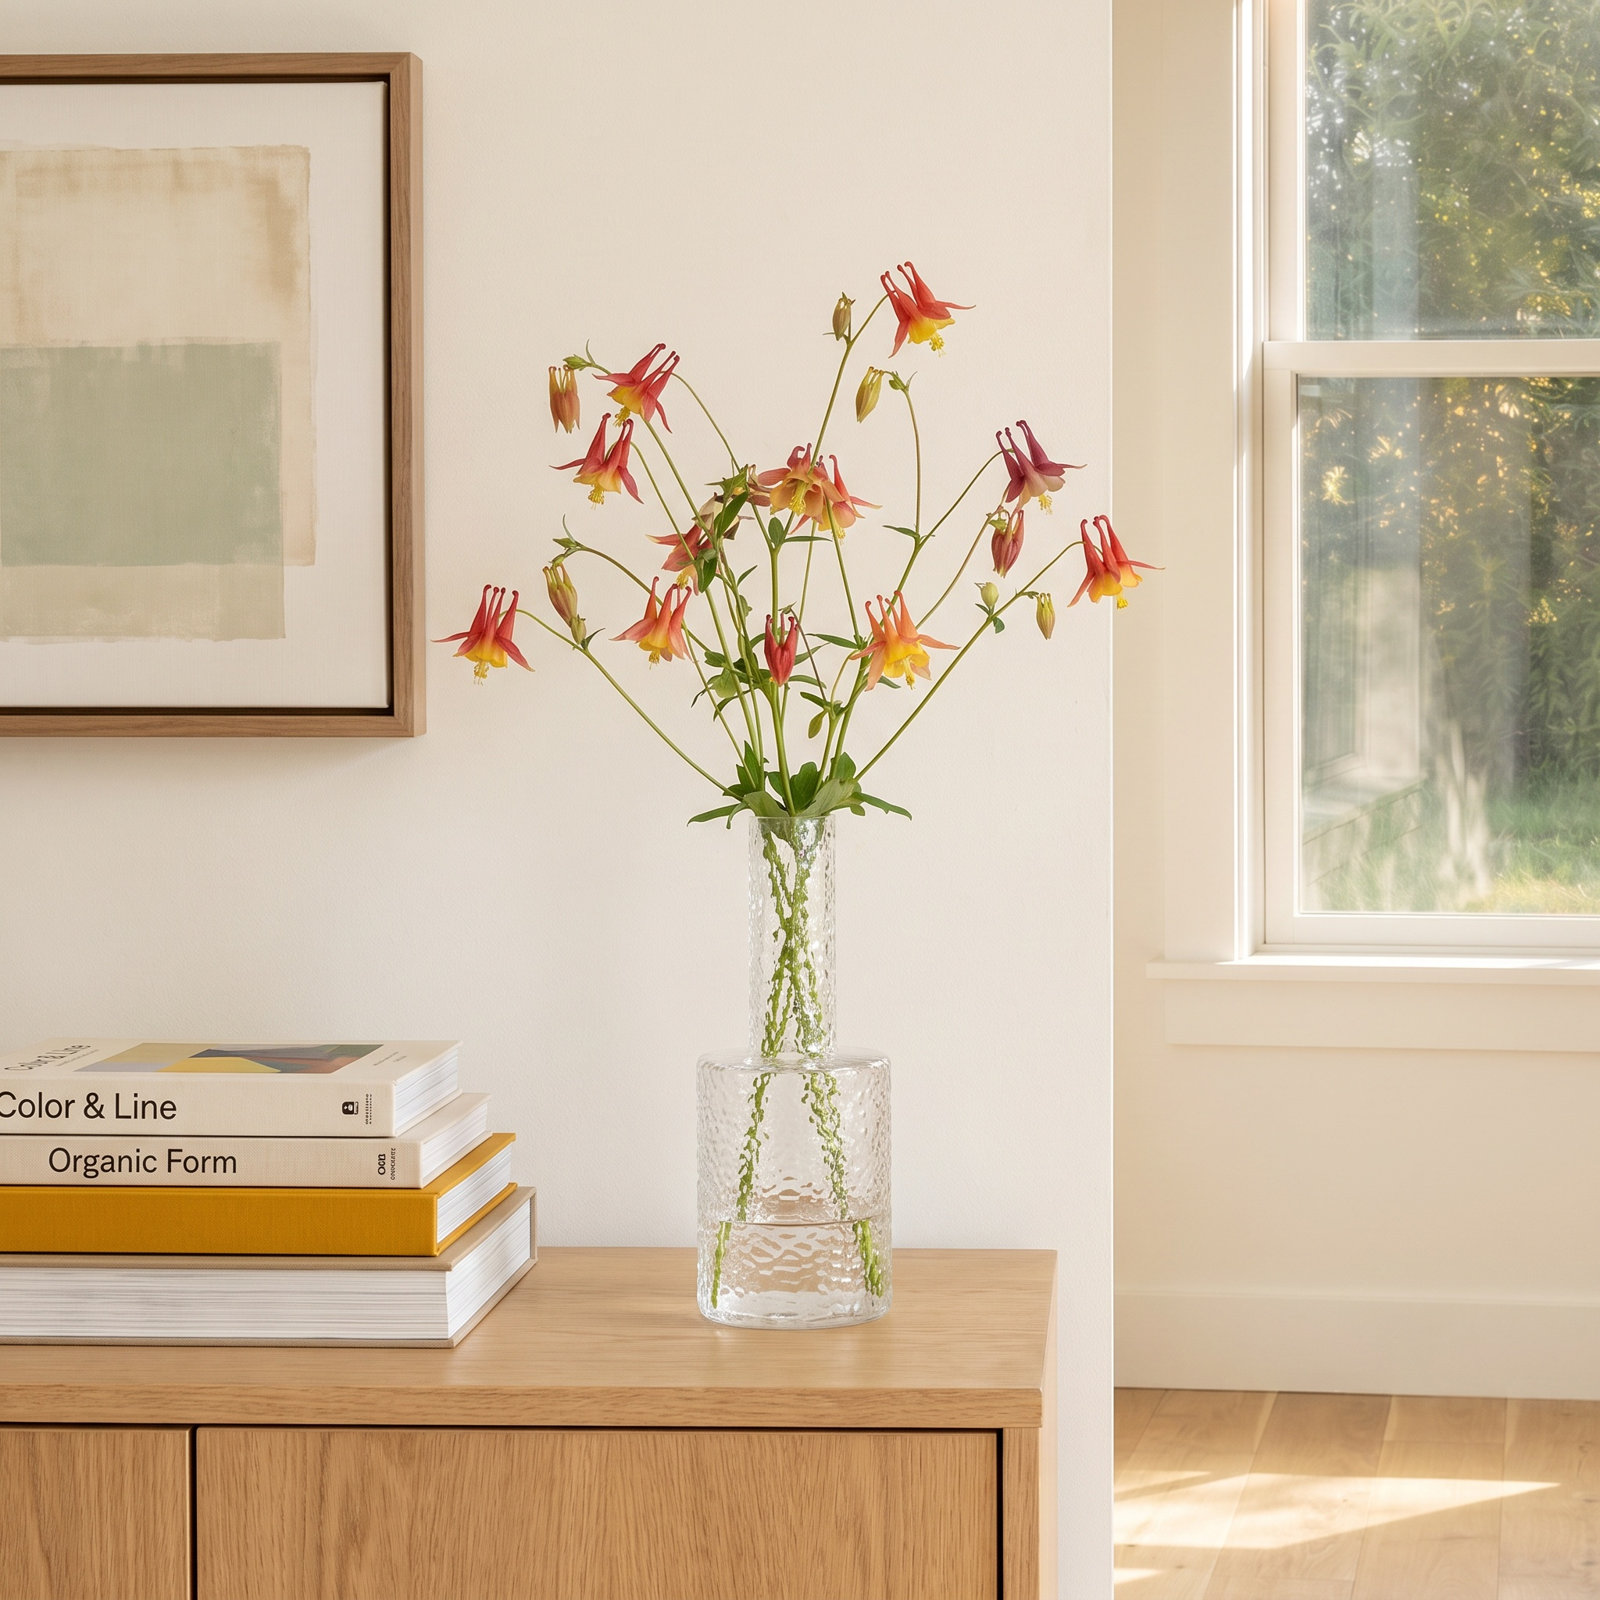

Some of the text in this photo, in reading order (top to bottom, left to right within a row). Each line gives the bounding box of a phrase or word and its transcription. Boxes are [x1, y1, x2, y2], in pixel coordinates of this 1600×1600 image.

[0, 1091, 177, 1119] Color & Line
[49, 1147, 237, 1179] Organic Form
